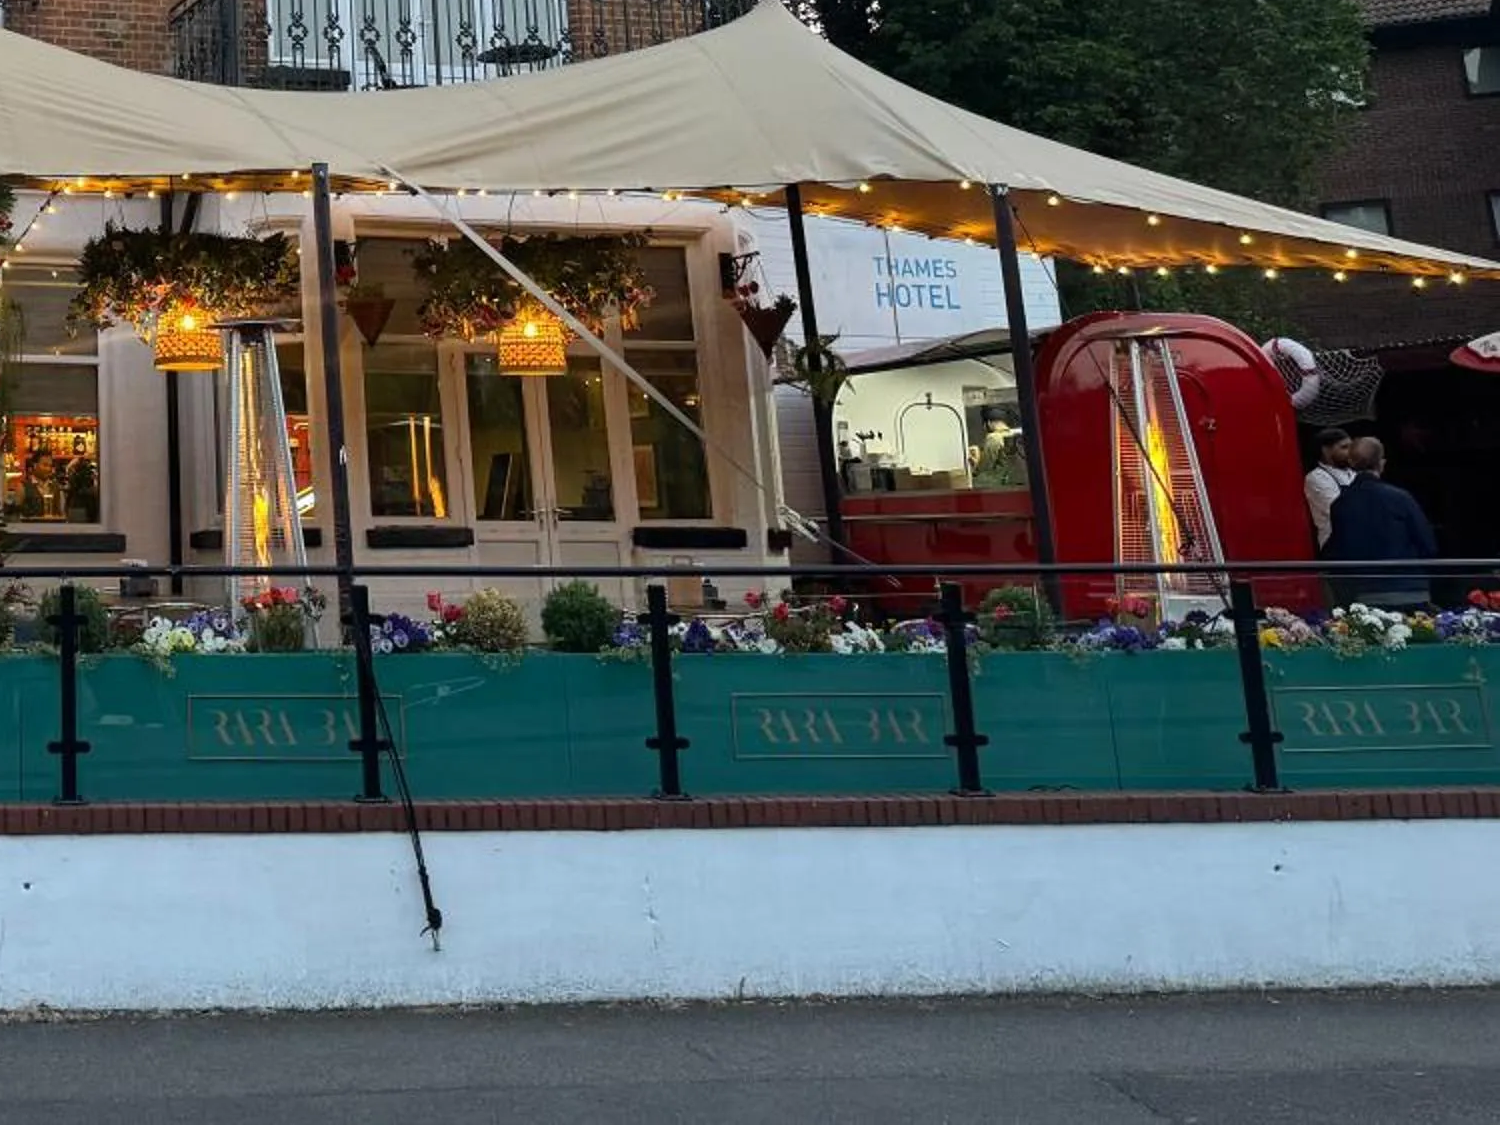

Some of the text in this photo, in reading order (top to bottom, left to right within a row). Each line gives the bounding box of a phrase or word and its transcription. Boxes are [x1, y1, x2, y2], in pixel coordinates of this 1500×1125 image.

[872, 256, 957, 279] THAMES
[875, 282, 961, 310] HOTEL
[207, 708, 372, 745] RARA BA
[754, 707, 930, 743] RARA BAR
[1292, 698, 1473, 736] RARA BAR
